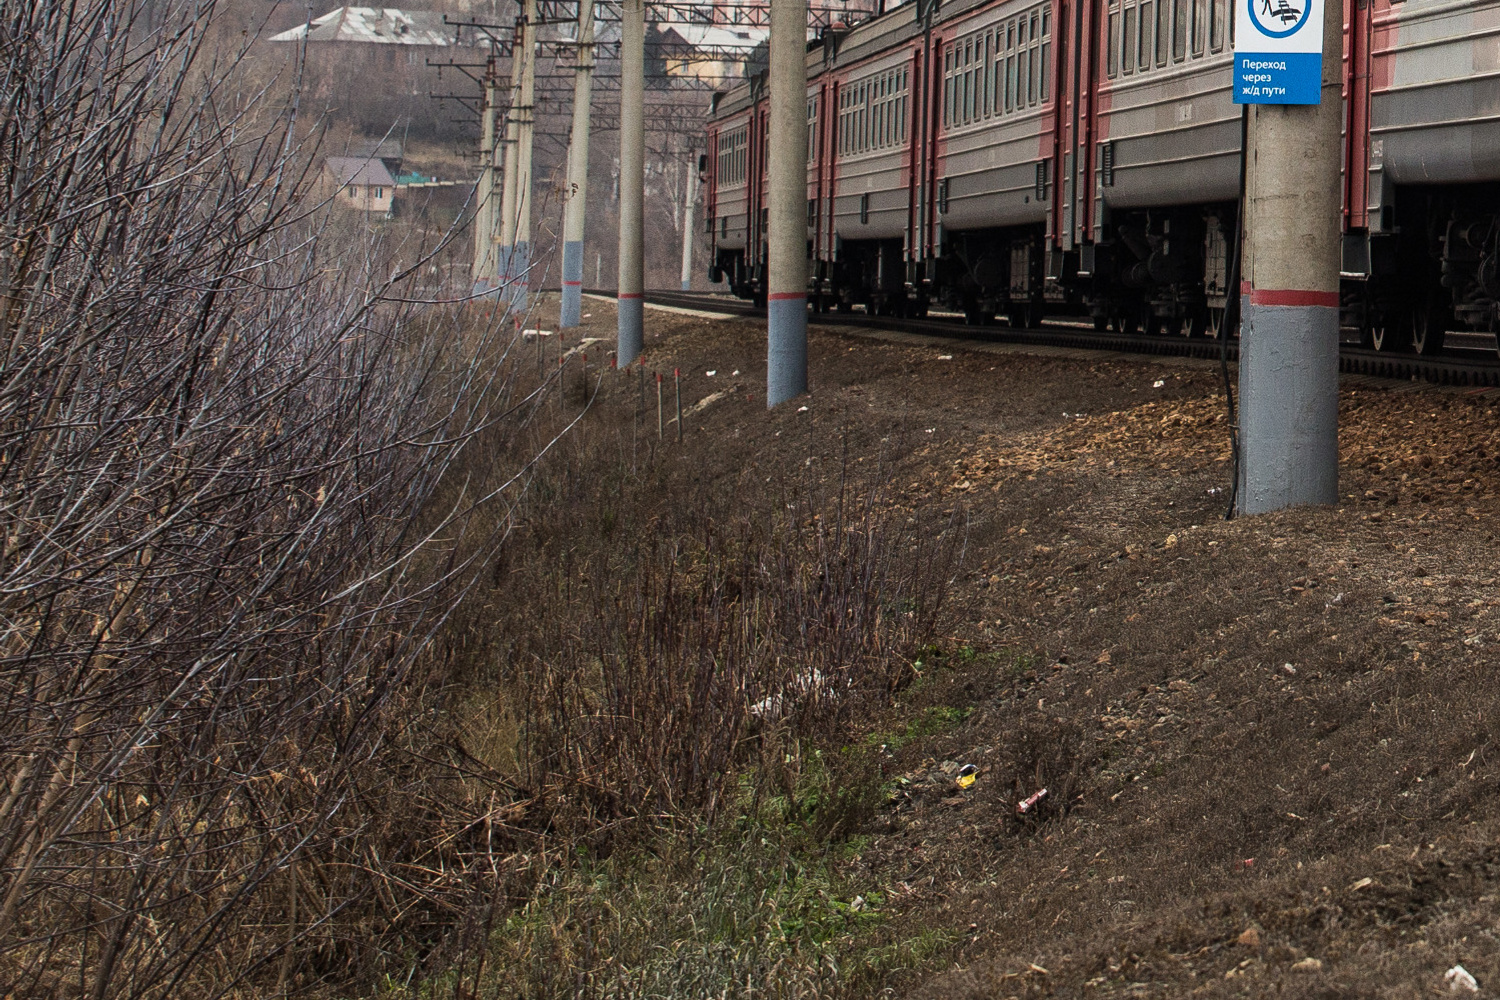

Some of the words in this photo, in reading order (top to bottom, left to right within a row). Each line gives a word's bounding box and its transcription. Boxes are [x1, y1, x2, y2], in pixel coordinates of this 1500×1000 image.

[1242, 59, 1287, 71] Переход
[1242, 74, 1272, 84] через
[1242, 85, 1260, 96] ж/д
[1262, 87, 1286, 98] пути
